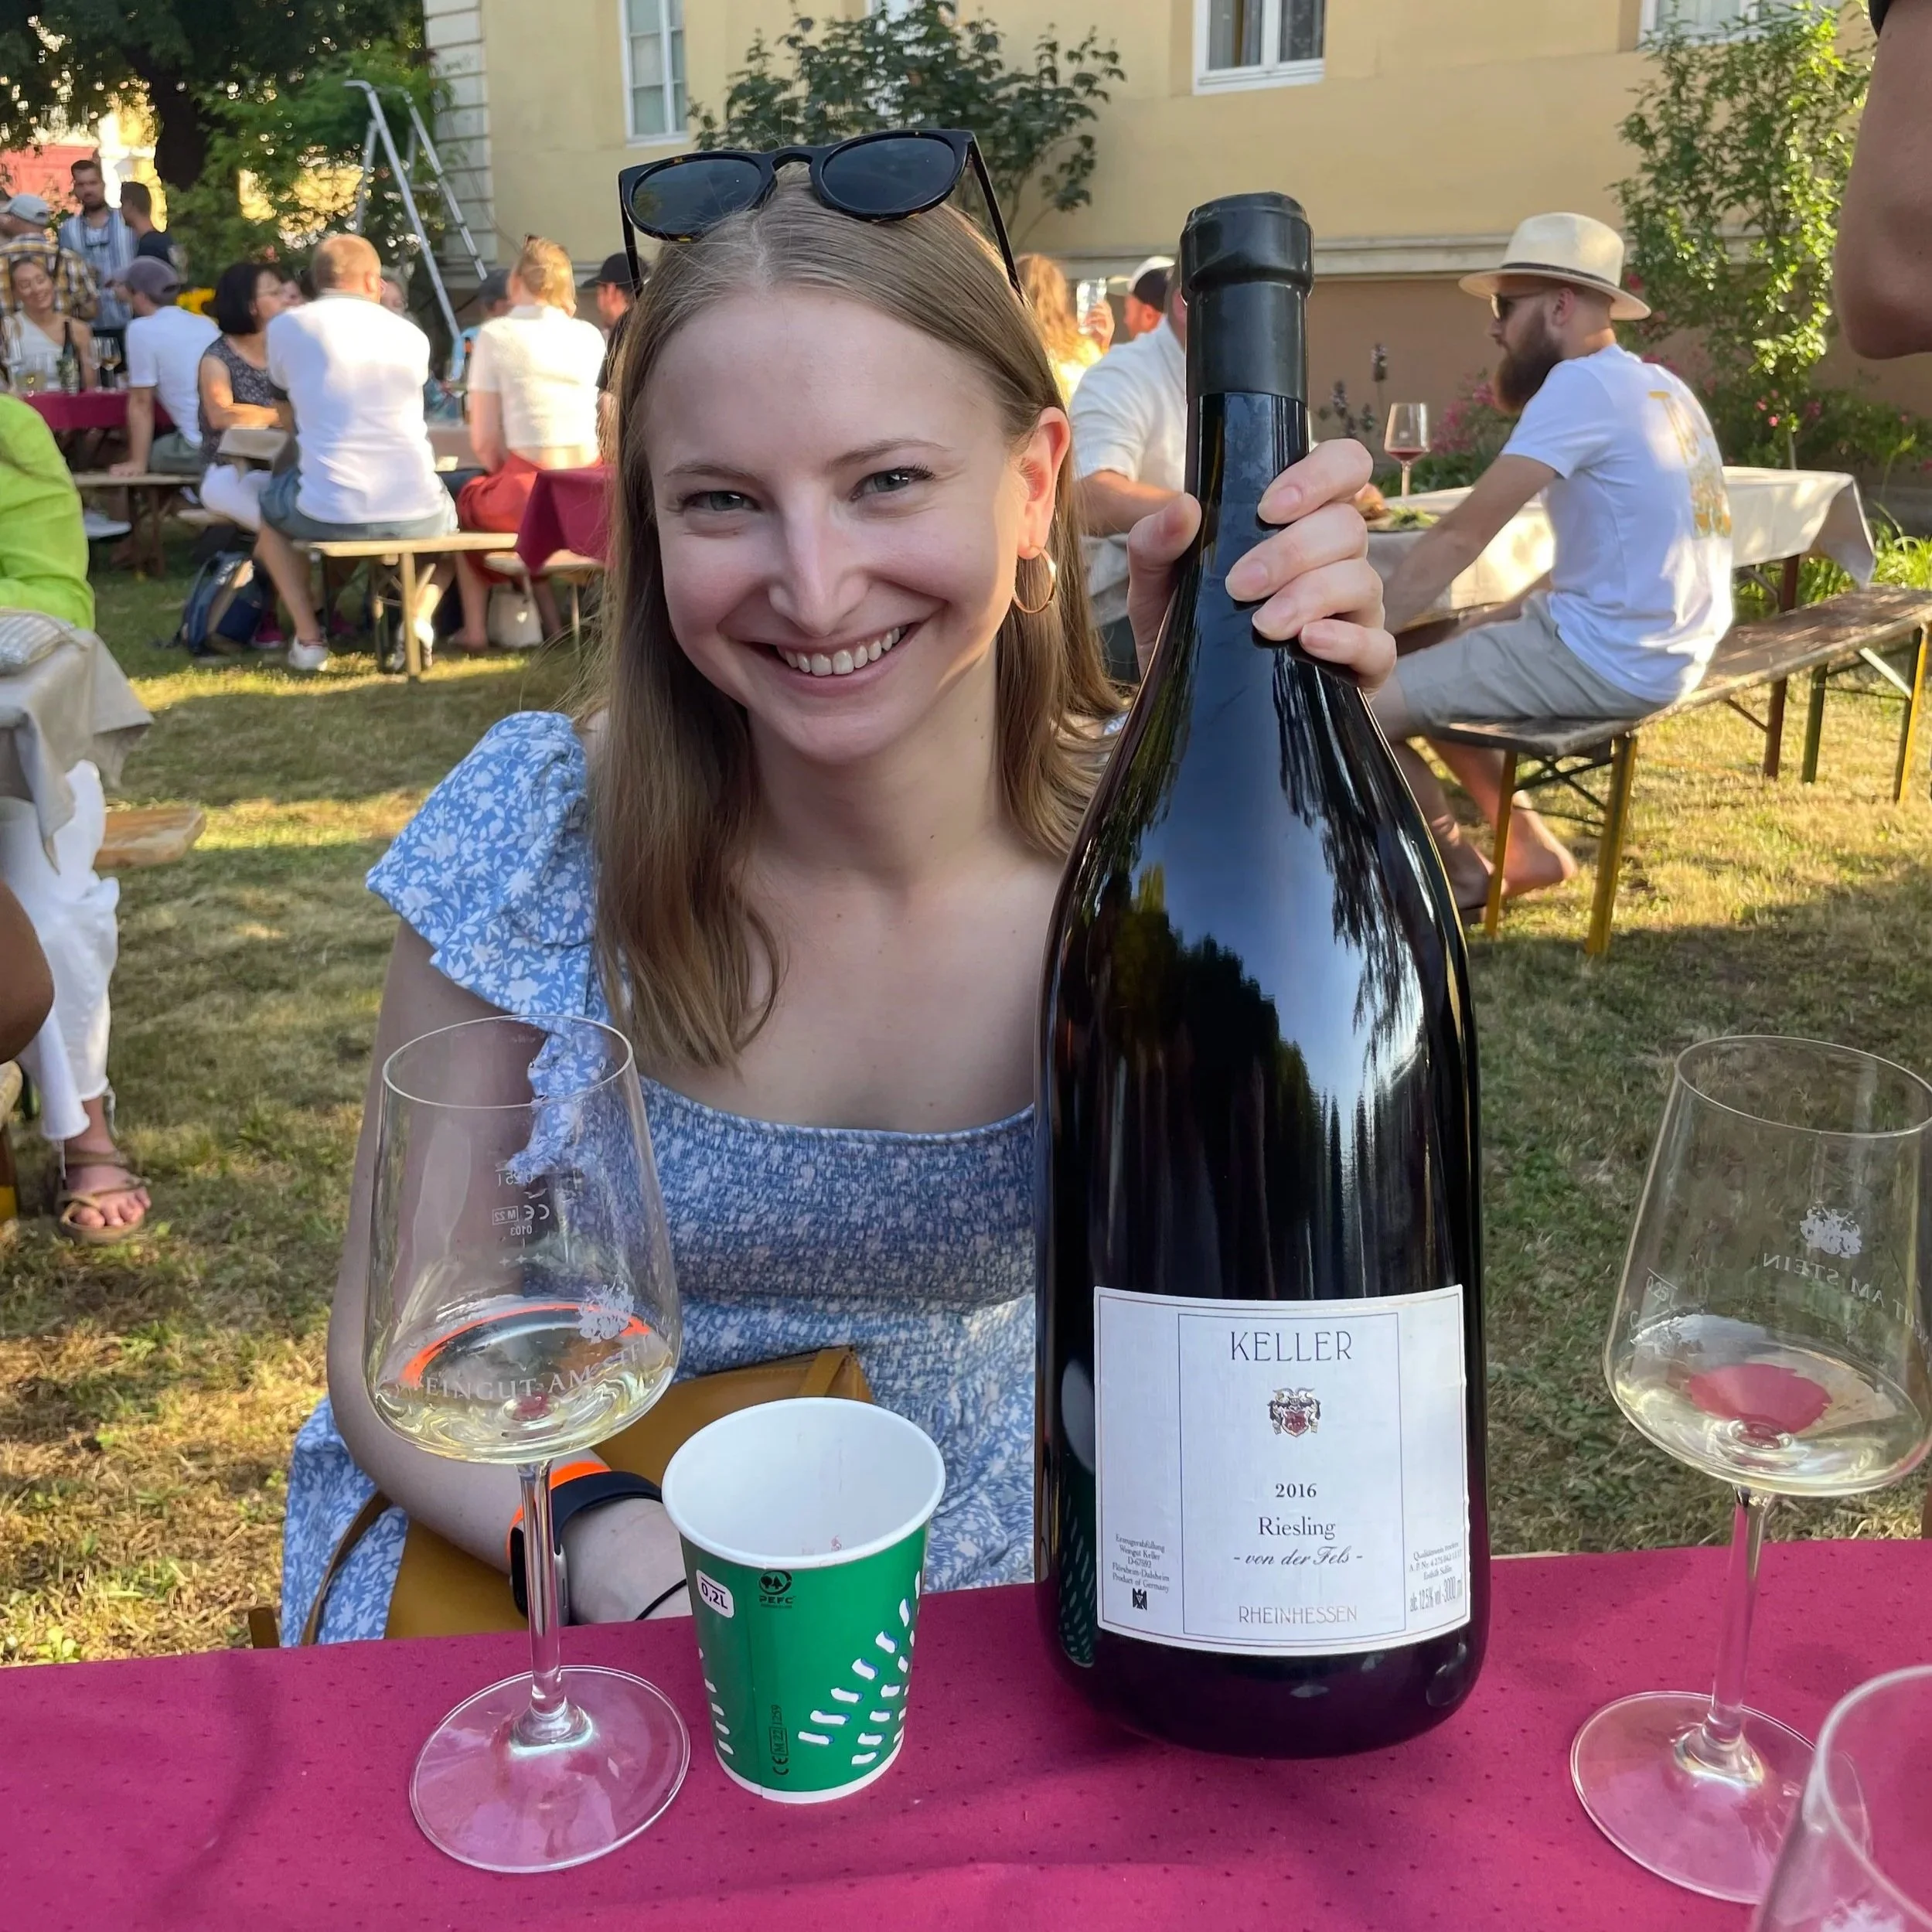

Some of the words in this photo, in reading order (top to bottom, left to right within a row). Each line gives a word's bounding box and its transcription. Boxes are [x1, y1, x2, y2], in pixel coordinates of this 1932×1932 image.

[1231, 1331, 1352, 1361] KELLER
[1275, 1483, 1317, 1498] 2016
[1259, 1516, 1336, 1541] Riesling
[1119, 1545, 1141, 1557] Weingut
[1143, 1550, 1160, 1560] Keller
[1245, 1554, 1275, 1566] von
[1281, 1549, 1311, 1566] der
[1313, 1545, 1352, 1566] Fels
[1113, 1573, 1133, 1585] Product
[1143, 1579, 1169, 1593] Germany
[700, 1582, 728, 1610] 0,2L
[758, 1595, 794, 1604] PEFC
[1239, 1606, 1358, 1624] RHEINHESSEN
